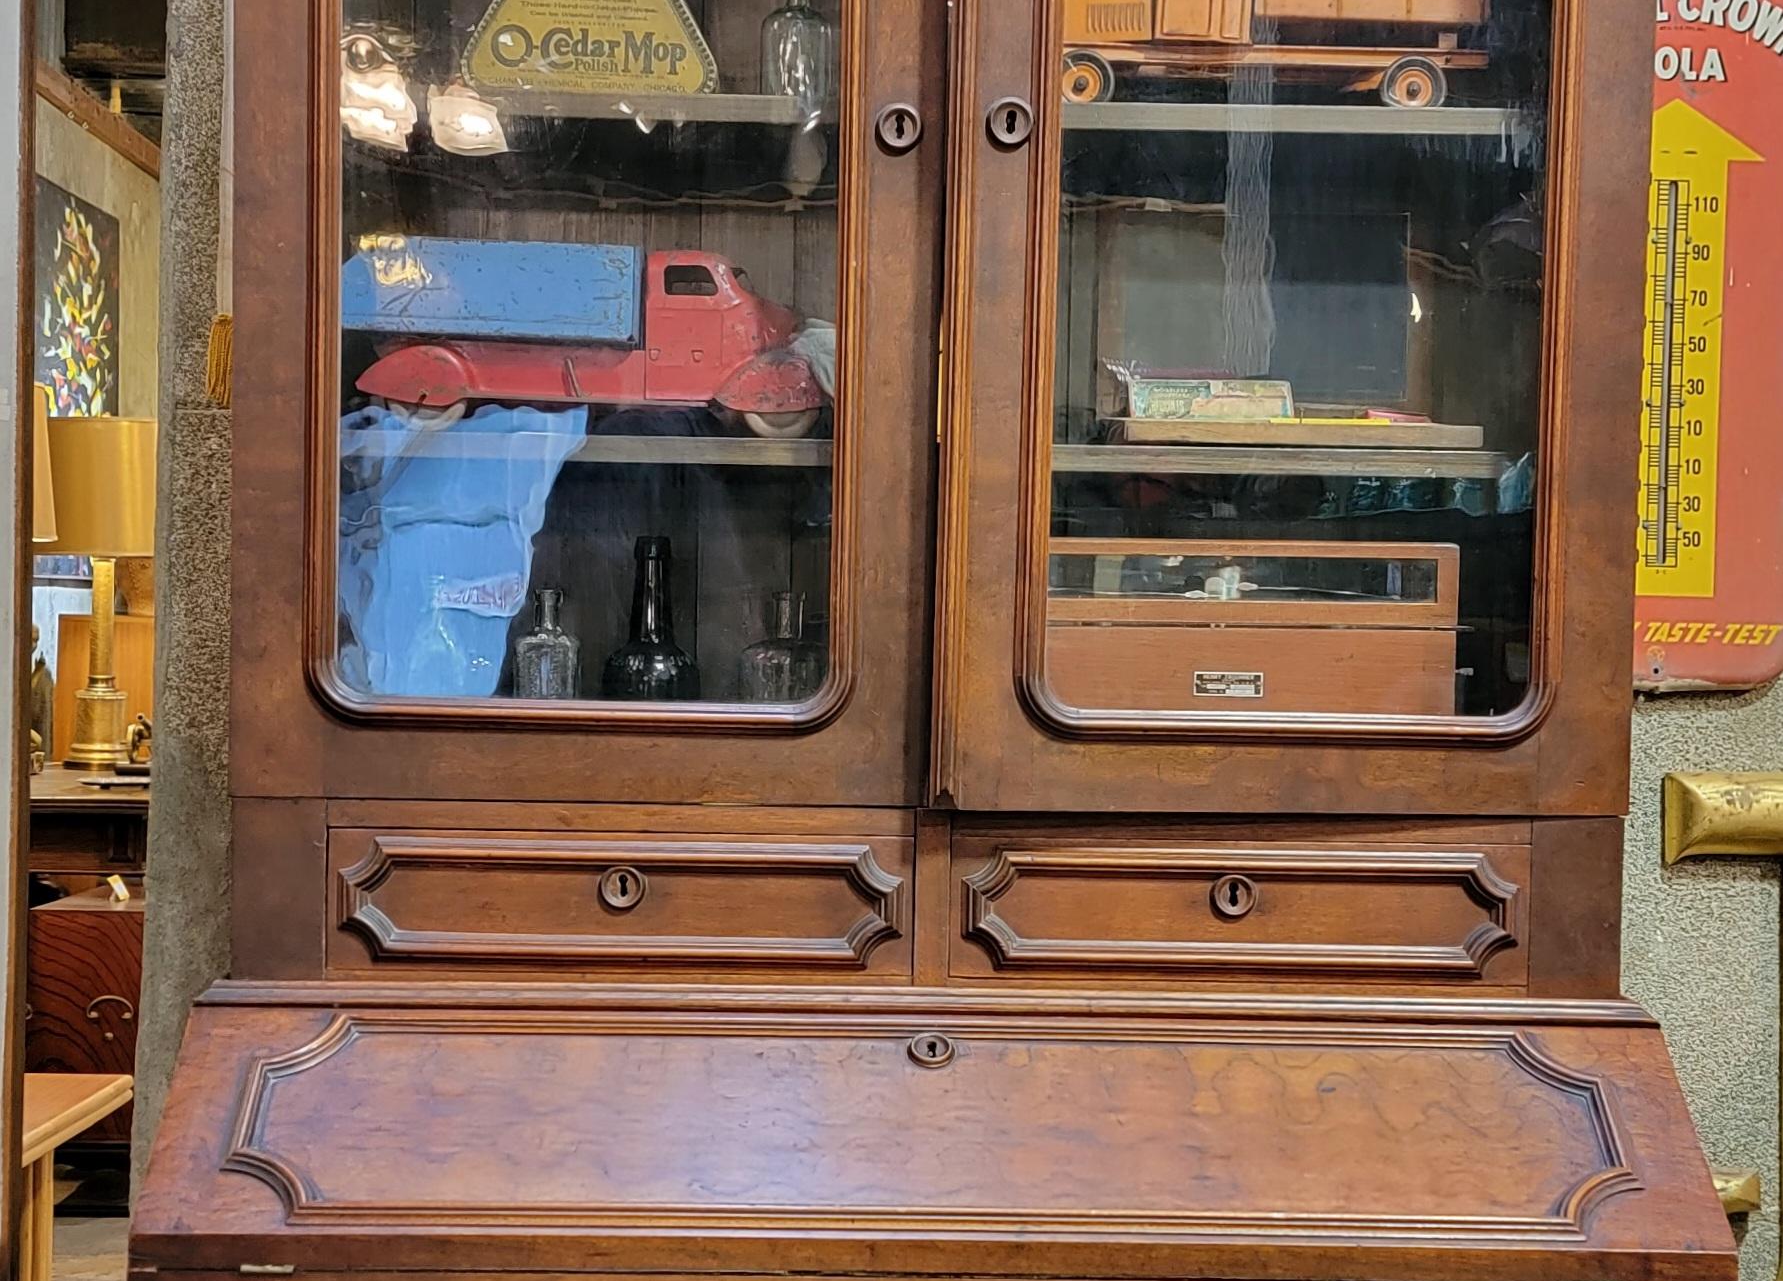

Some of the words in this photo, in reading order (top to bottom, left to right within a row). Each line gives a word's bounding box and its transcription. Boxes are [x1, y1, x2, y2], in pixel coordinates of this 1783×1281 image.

[622, 30, 687, 76] Mop
[574, 58, 618, 73] Polish
[1655, 46, 1728, 81] OLA
[1694, 196, 1719, 213] 110
[1692, 244, 1710, 261] 90
[1690, 290, 1708, 306] 70
[1688, 336, 1706, 352] 50
[1686, 379, 1704, 395] 30
[1686, 420, 1702, 436] 10
[1684, 459, 1701, 475] 10
[1682, 496, 1700, 512] 30
[1682, 531, 1701, 547] 50
[1643, 622, 1783, 645] TASTE-TEST
